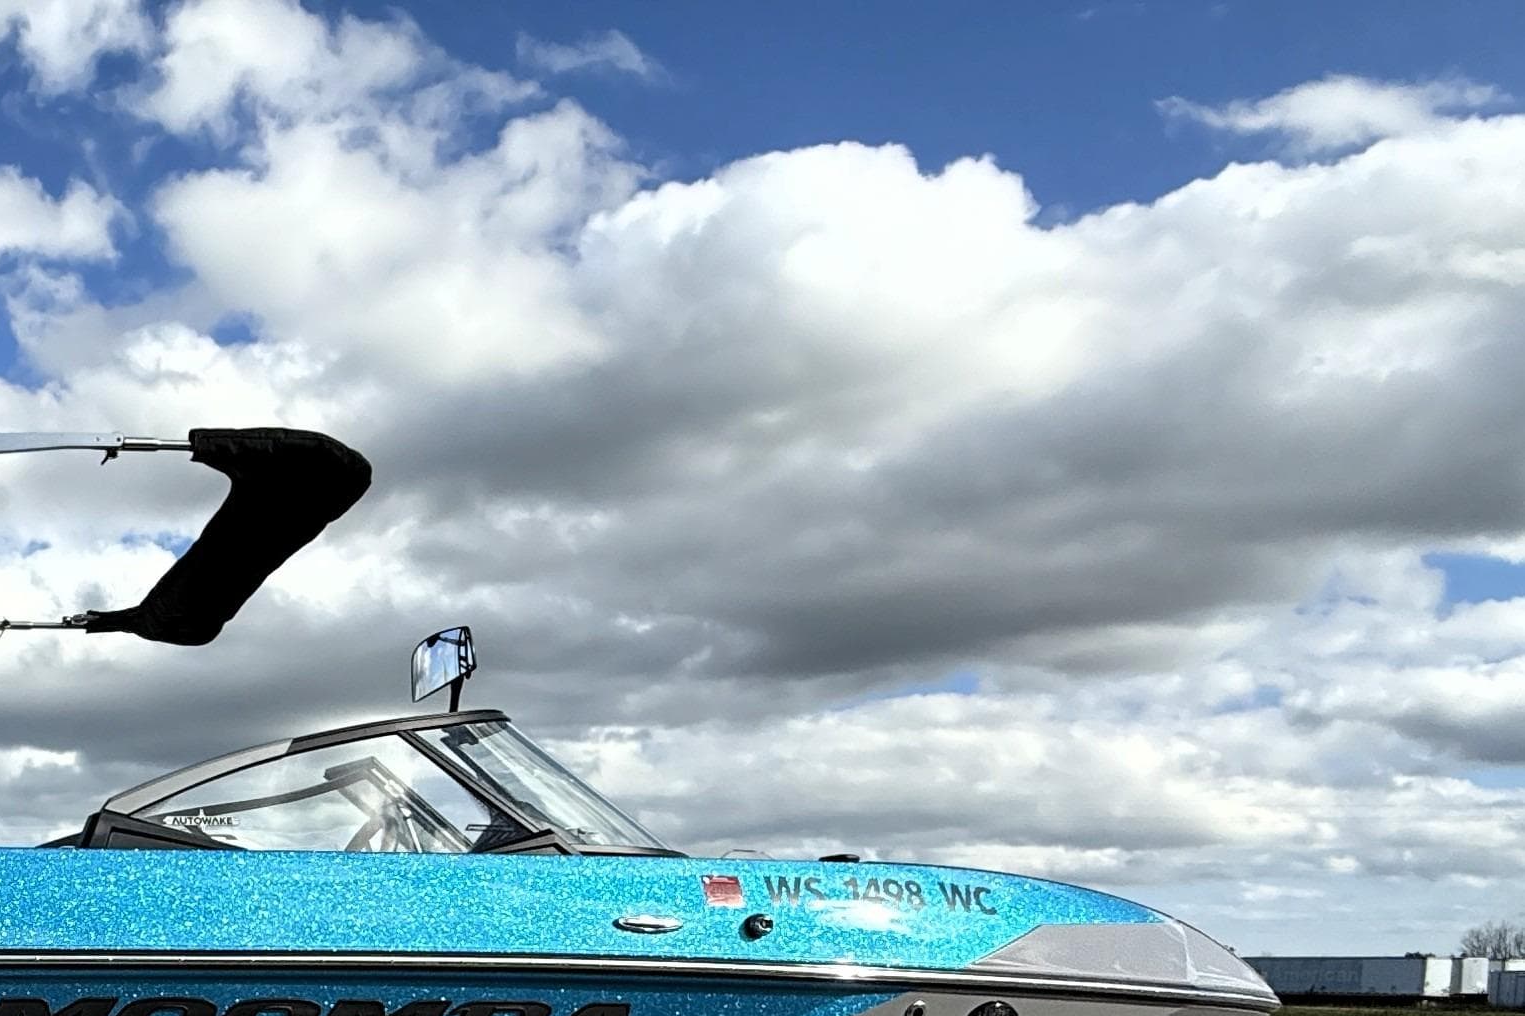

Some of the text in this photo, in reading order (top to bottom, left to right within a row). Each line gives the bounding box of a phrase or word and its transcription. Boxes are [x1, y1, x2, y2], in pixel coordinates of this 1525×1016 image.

[172, 816, 233, 825] AUTOWAKE
[764, 875, 827, 905] WS
[937, 881, 998, 916] WC
